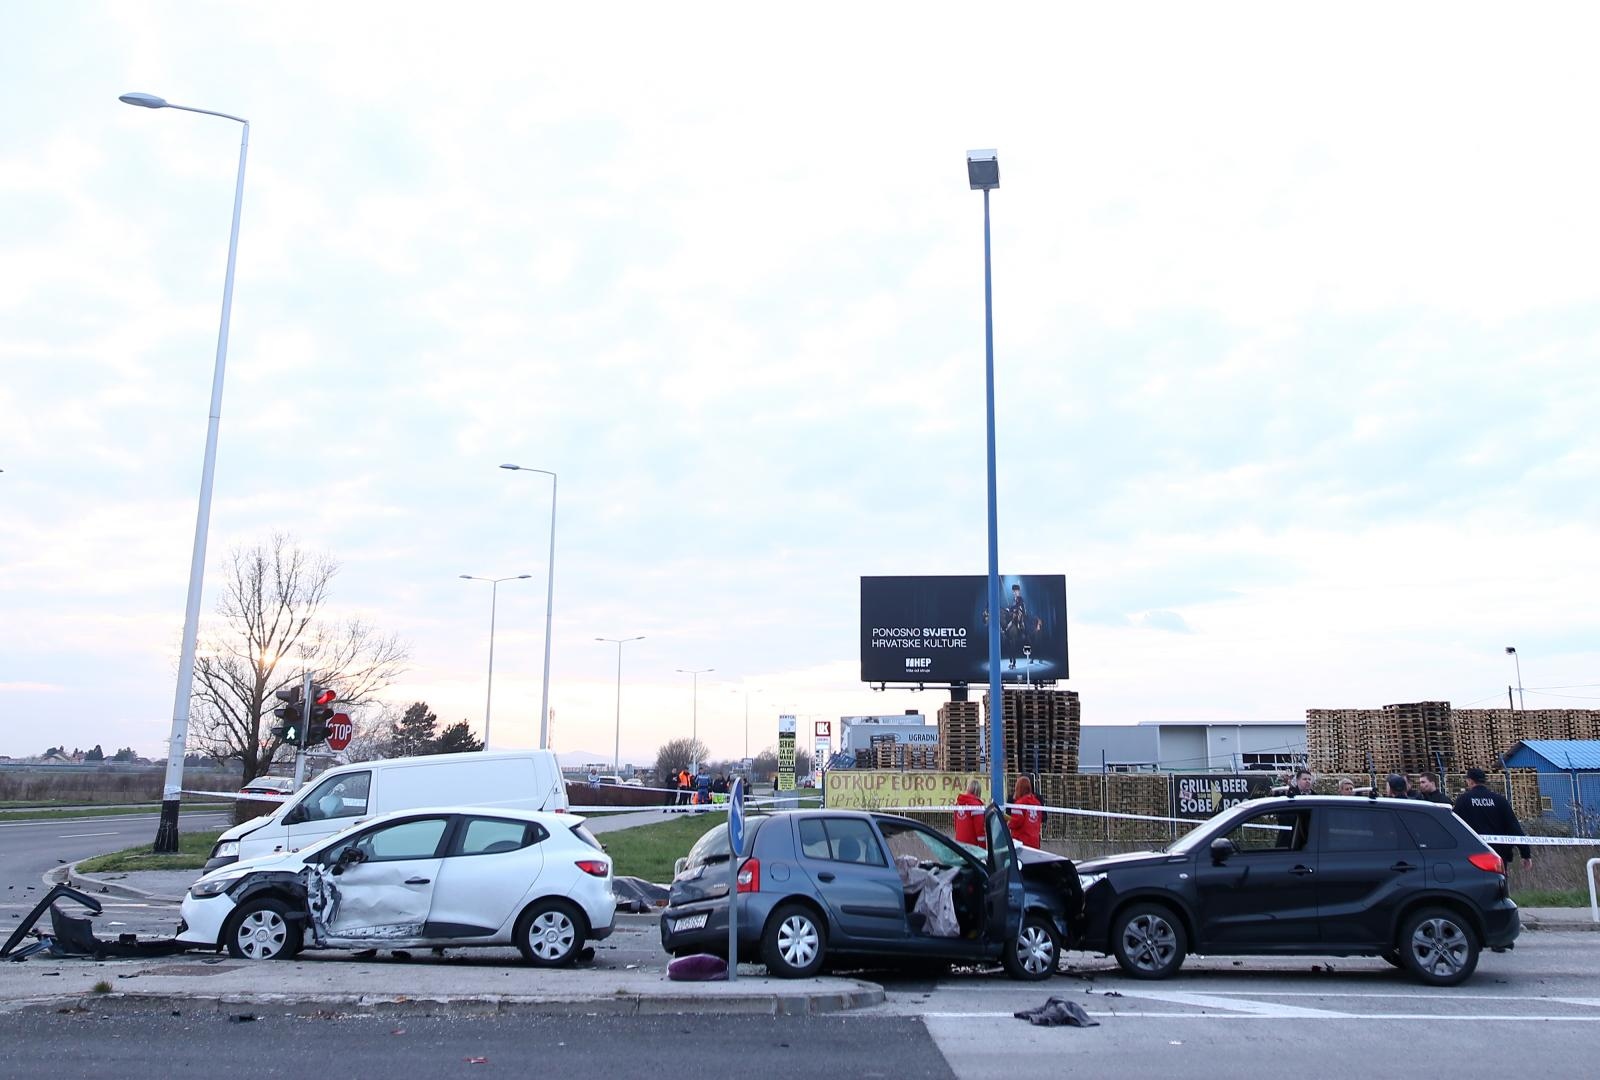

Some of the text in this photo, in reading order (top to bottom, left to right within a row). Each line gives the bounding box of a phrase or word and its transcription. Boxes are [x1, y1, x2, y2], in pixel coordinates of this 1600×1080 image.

[872, 628, 967, 637] PONOSNO SVJETLO
[872, 639, 967, 648] HRVATSKE KULTURE
[915, 658, 931, 667] HEP
[328, 724, 351, 740] STOP
[830, 775, 886, 790] OTKUP
[891, 776, 937, 791] EURO
[1180, 779, 1212, 793] GRILL
[1222, 779, 1248, 793] BEER
[1180, 799, 1212, 813] SOBE
[1471, 798, 1495, 807] POLICIJA
